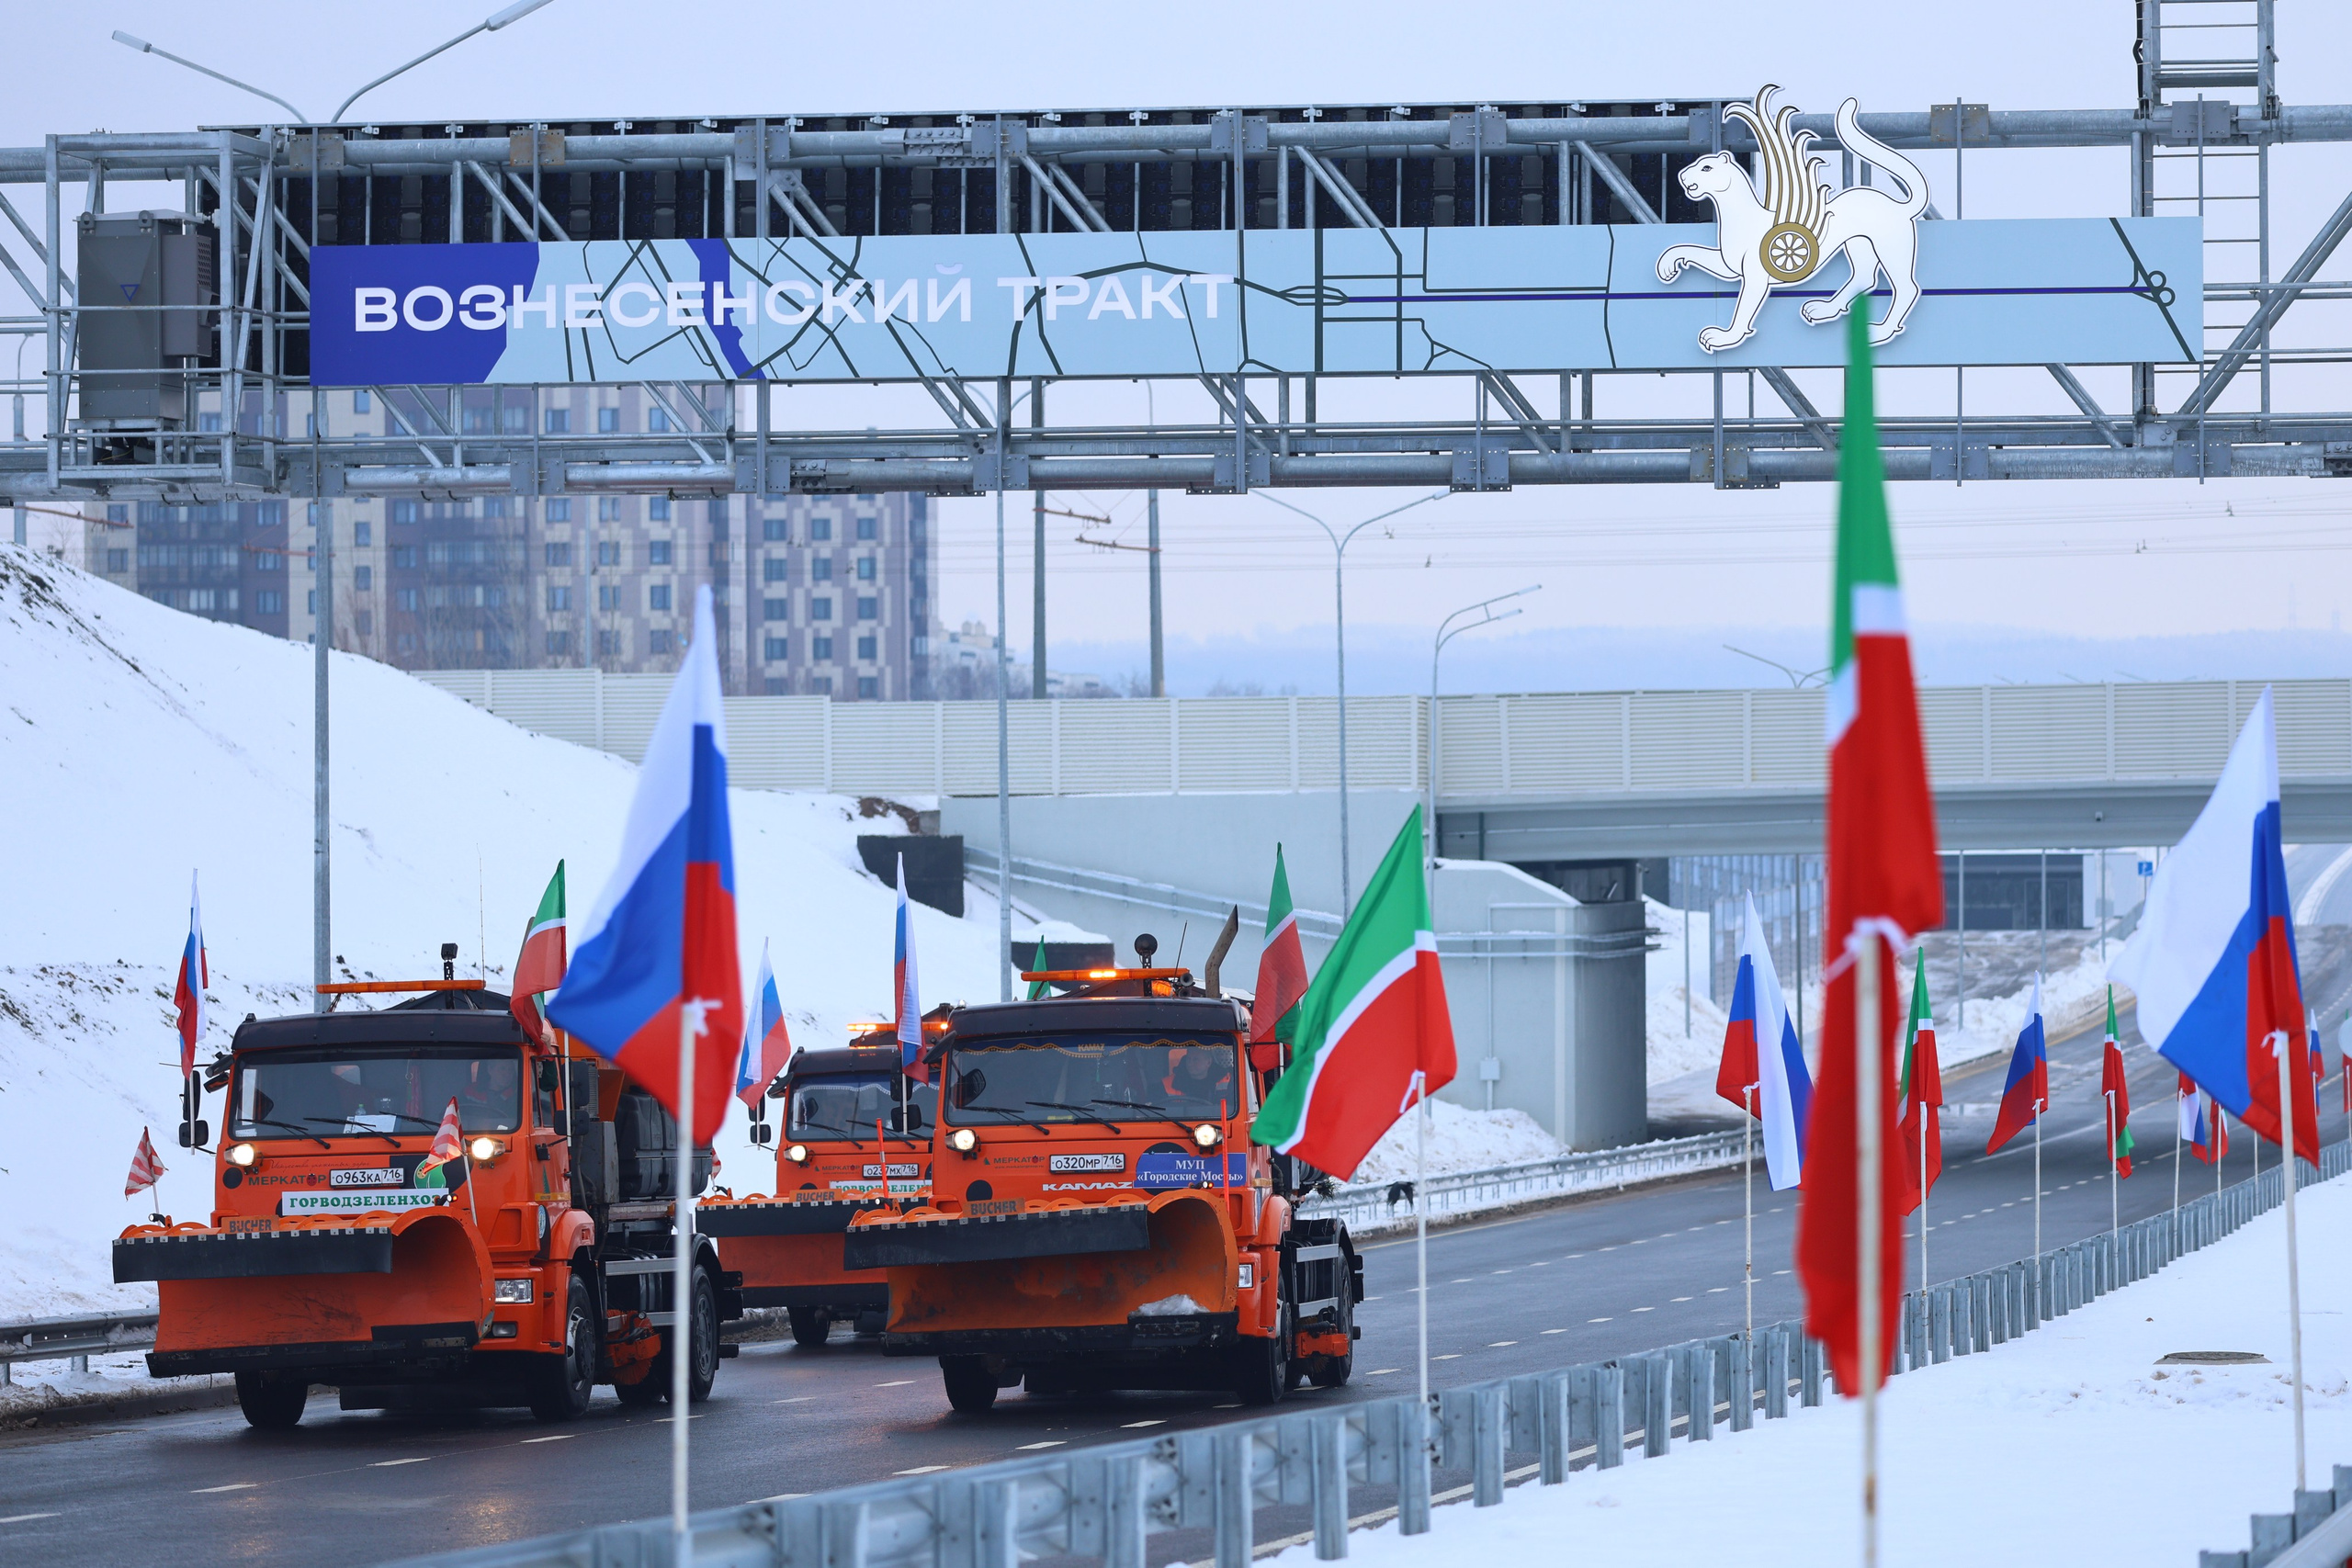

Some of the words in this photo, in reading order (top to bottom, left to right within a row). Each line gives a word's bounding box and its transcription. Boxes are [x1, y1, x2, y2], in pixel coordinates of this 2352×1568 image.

[355, 263, 971, 333] ВОЗНЕСЕНСКИЙ
[997, 274, 1235, 321] ТРАКТ
[1102, 1155, 1121, 1165] 716
[1175, 1160, 1204, 1169] МУП
[335, 1170, 381, 1184] О963КА
[382, 1168, 401, 1179] 716
[1136, 1170, 1198, 1184] «Городские
[1200, 1170, 1244, 1182] Мосы»
[1042, 1181, 1132, 1191] KAMAZ
[796, 1190, 835, 1202] BUCHER
[970, 1201, 1016, 1215] BUCHER
